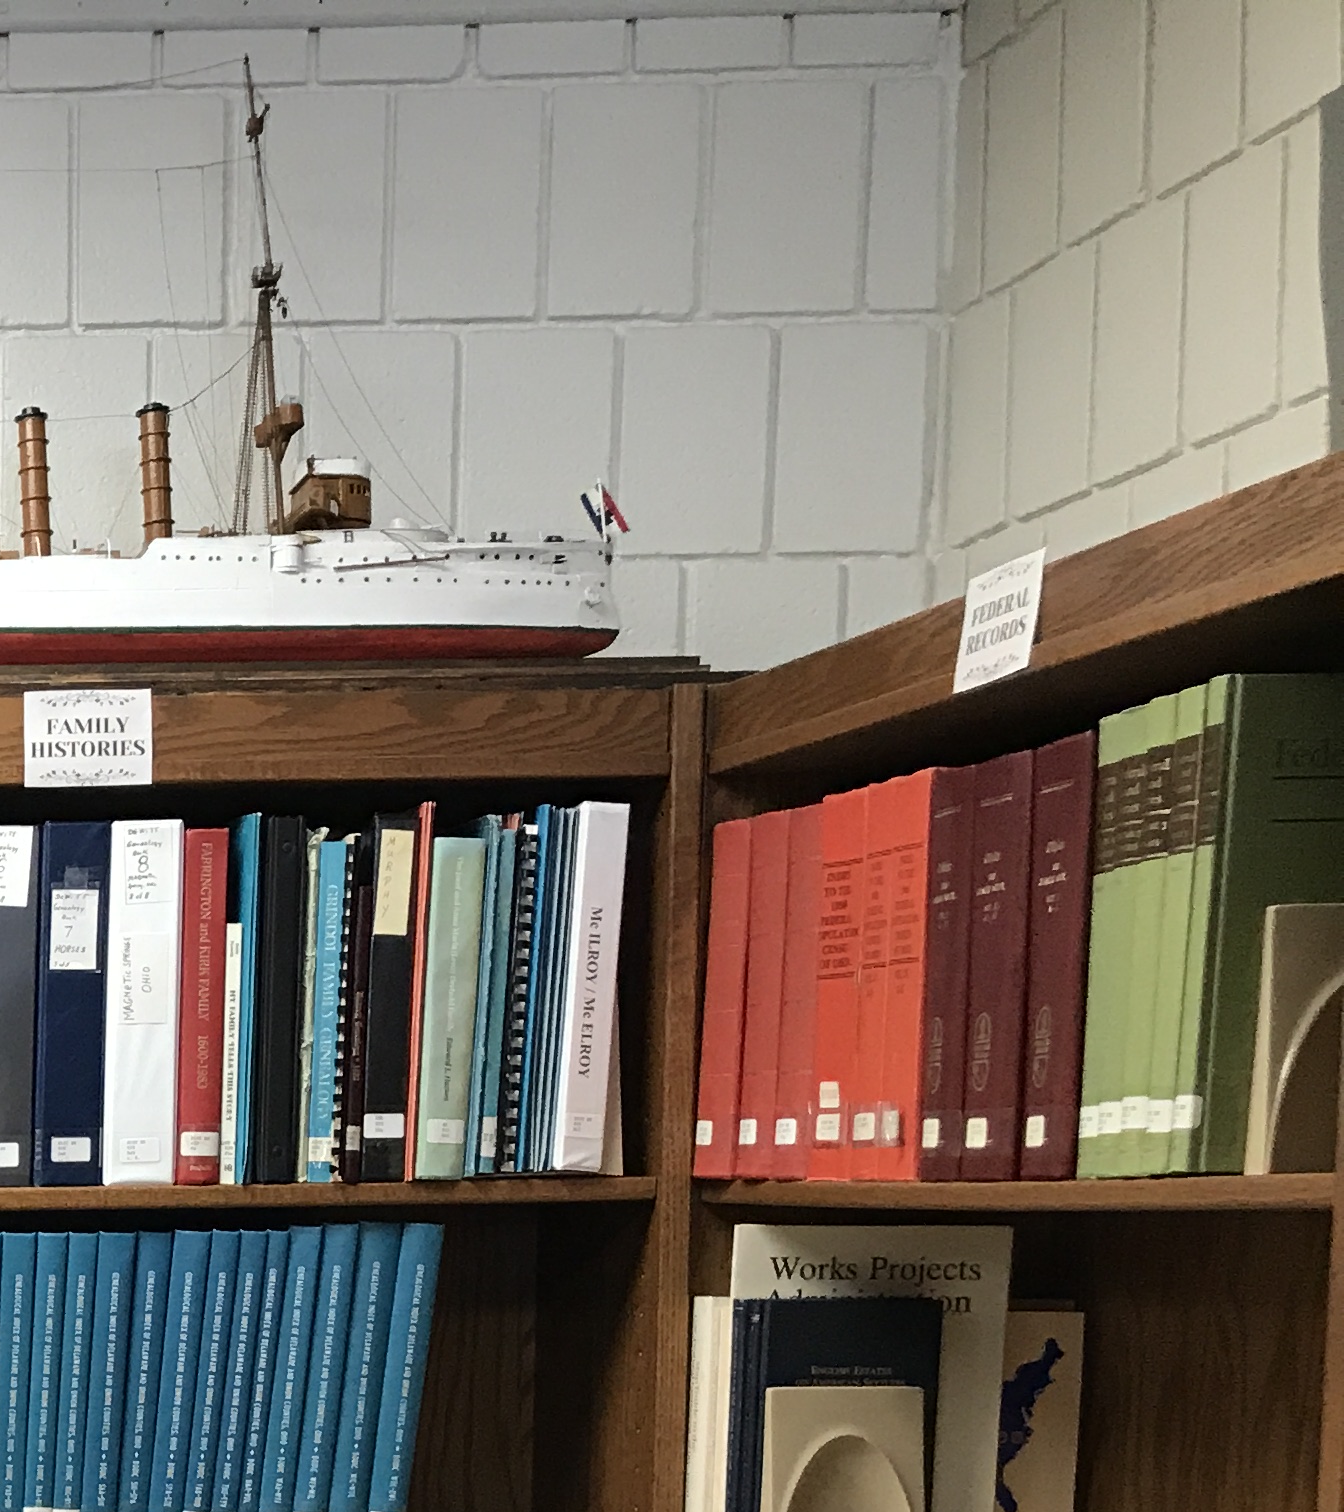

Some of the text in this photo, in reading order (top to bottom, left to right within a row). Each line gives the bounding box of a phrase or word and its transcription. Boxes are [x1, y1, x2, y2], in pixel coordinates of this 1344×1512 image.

[971, 586, 1030, 627] FEDERAL
[965, 614, 1029, 656] RECORDS
[46, 716, 130, 735] FAMILY
[31, 739, 146, 758] HISTORIES
[199, 842, 213, 921] FARRINGTON
[198, 922, 211, 944] and
[588, 906, 603, 930] Mc
[198, 945, 211, 976] KIRK
[585, 933, 601, 984] ILROY
[141, 966, 152, 994] OHIO
[320, 962, 336, 1020] FAMILY
[196, 977, 211, 1022] FAMILY
[582, 996, 597, 1020] Mc
[577, 1022, 594, 1080] ELROY
[315, 1027, 334, 1121] GENEALOGY
[769, 1255, 982, 1285] Works Projects
